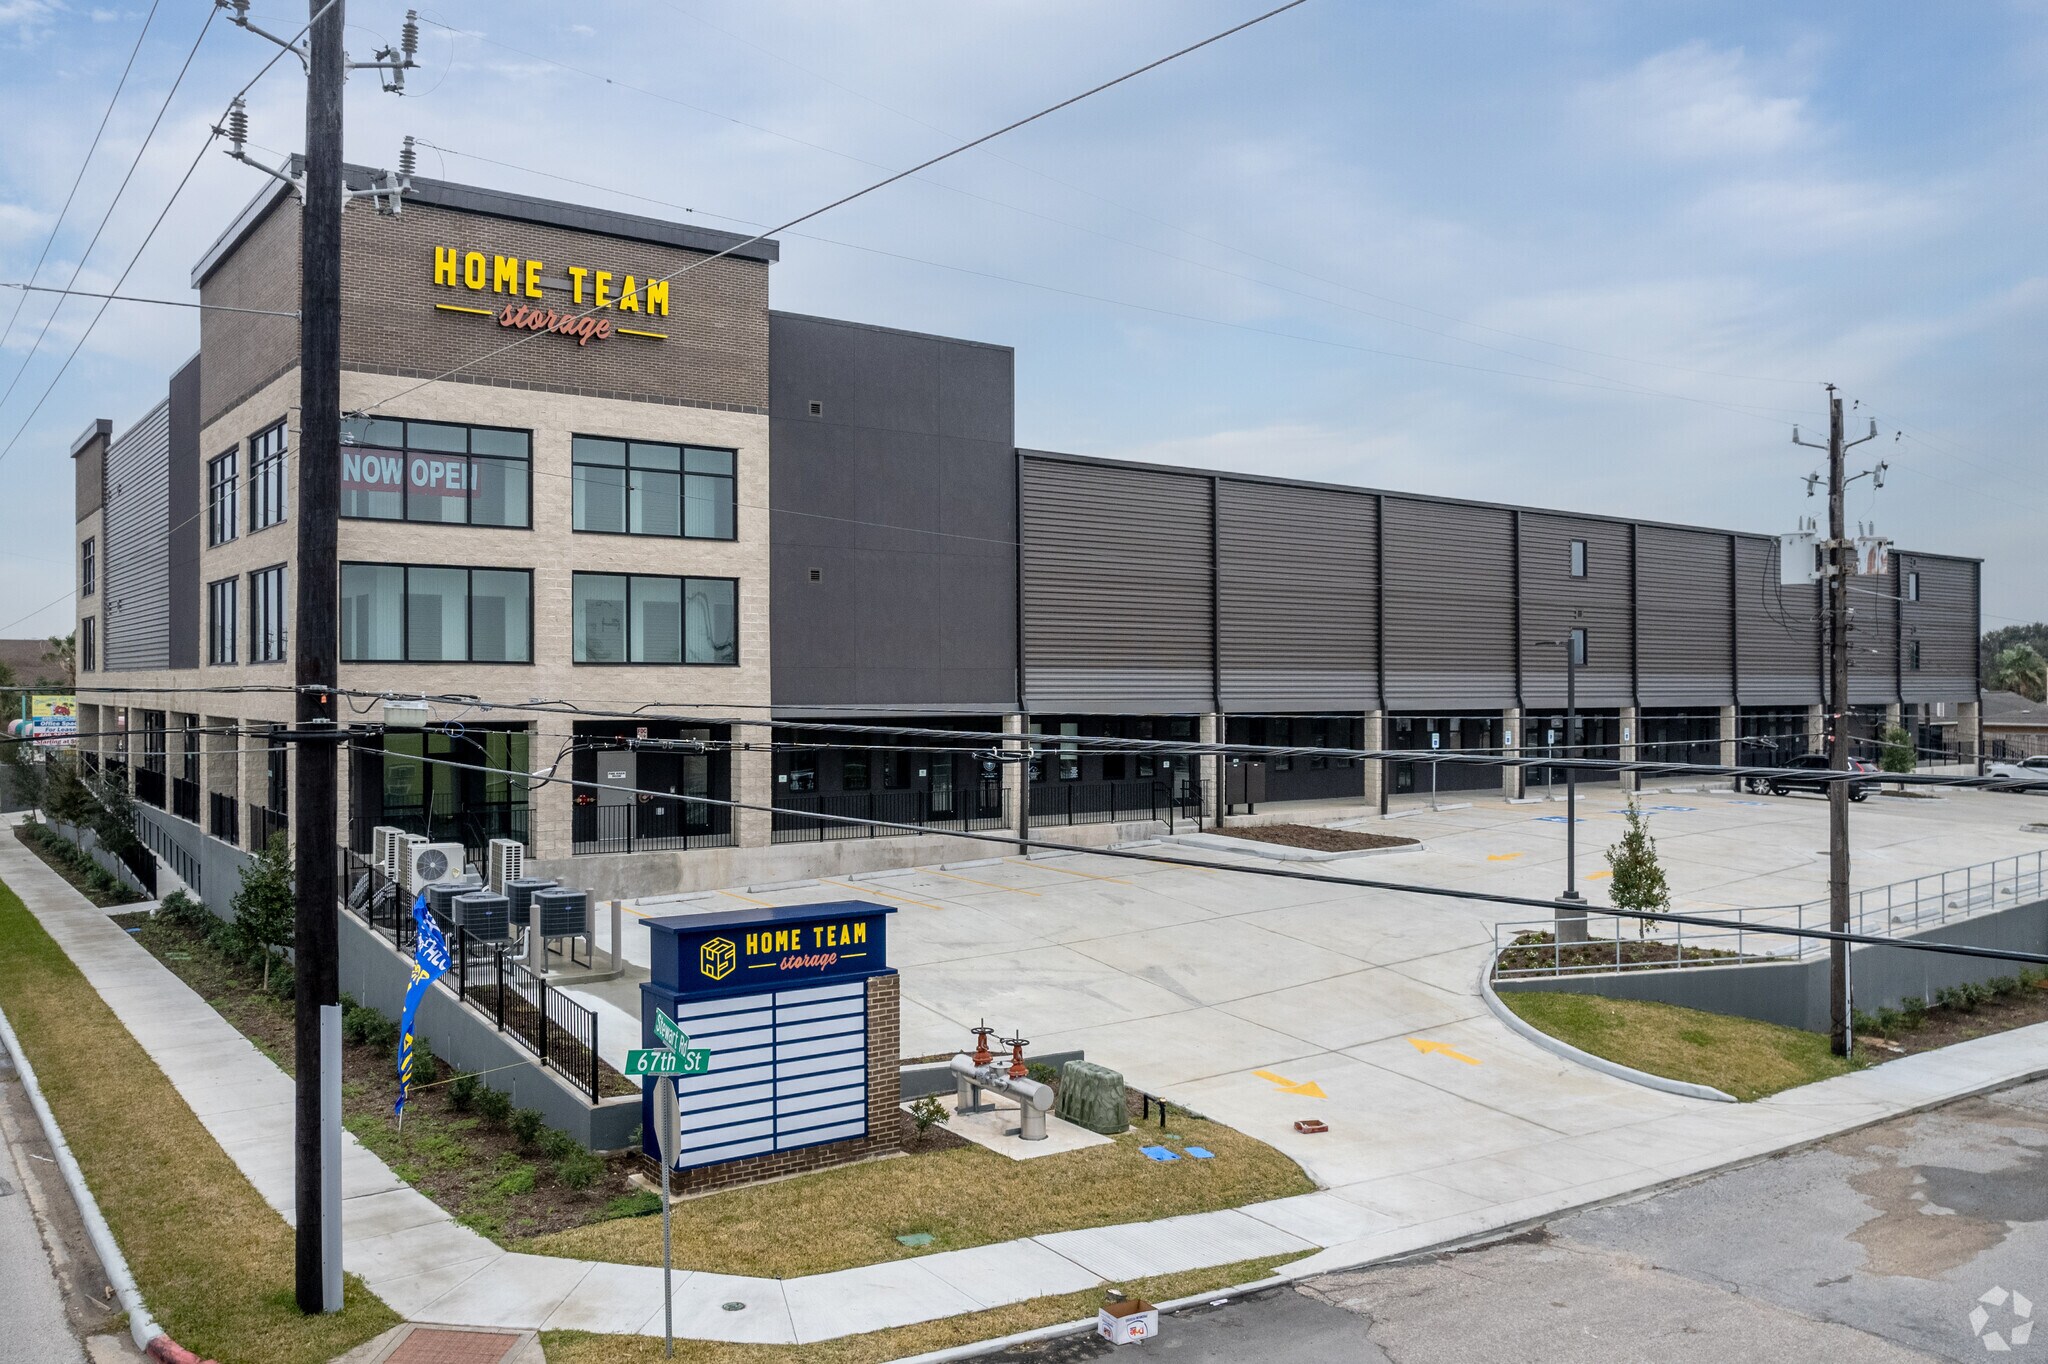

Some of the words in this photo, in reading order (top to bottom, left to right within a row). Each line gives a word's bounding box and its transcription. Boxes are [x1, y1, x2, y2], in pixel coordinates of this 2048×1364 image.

[434, 246, 543, 298] HOME
[568, 266, 669, 316] TEAM
[499, 304, 612, 346] storage
[343, 453, 403, 485] NOW
[411, 458, 478, 490] OPEN
[746, 929, 801, 955] HOME
[813, 922, 867, 948] TEAM
[779, 952, 837, 971] storage
[656, 1013, 678, 1049] Stewart
[678, 1035, 688, 1058] Rd
[637, 1052, 676, 1072] 67th
[684, 1051, 702, 1071] St
